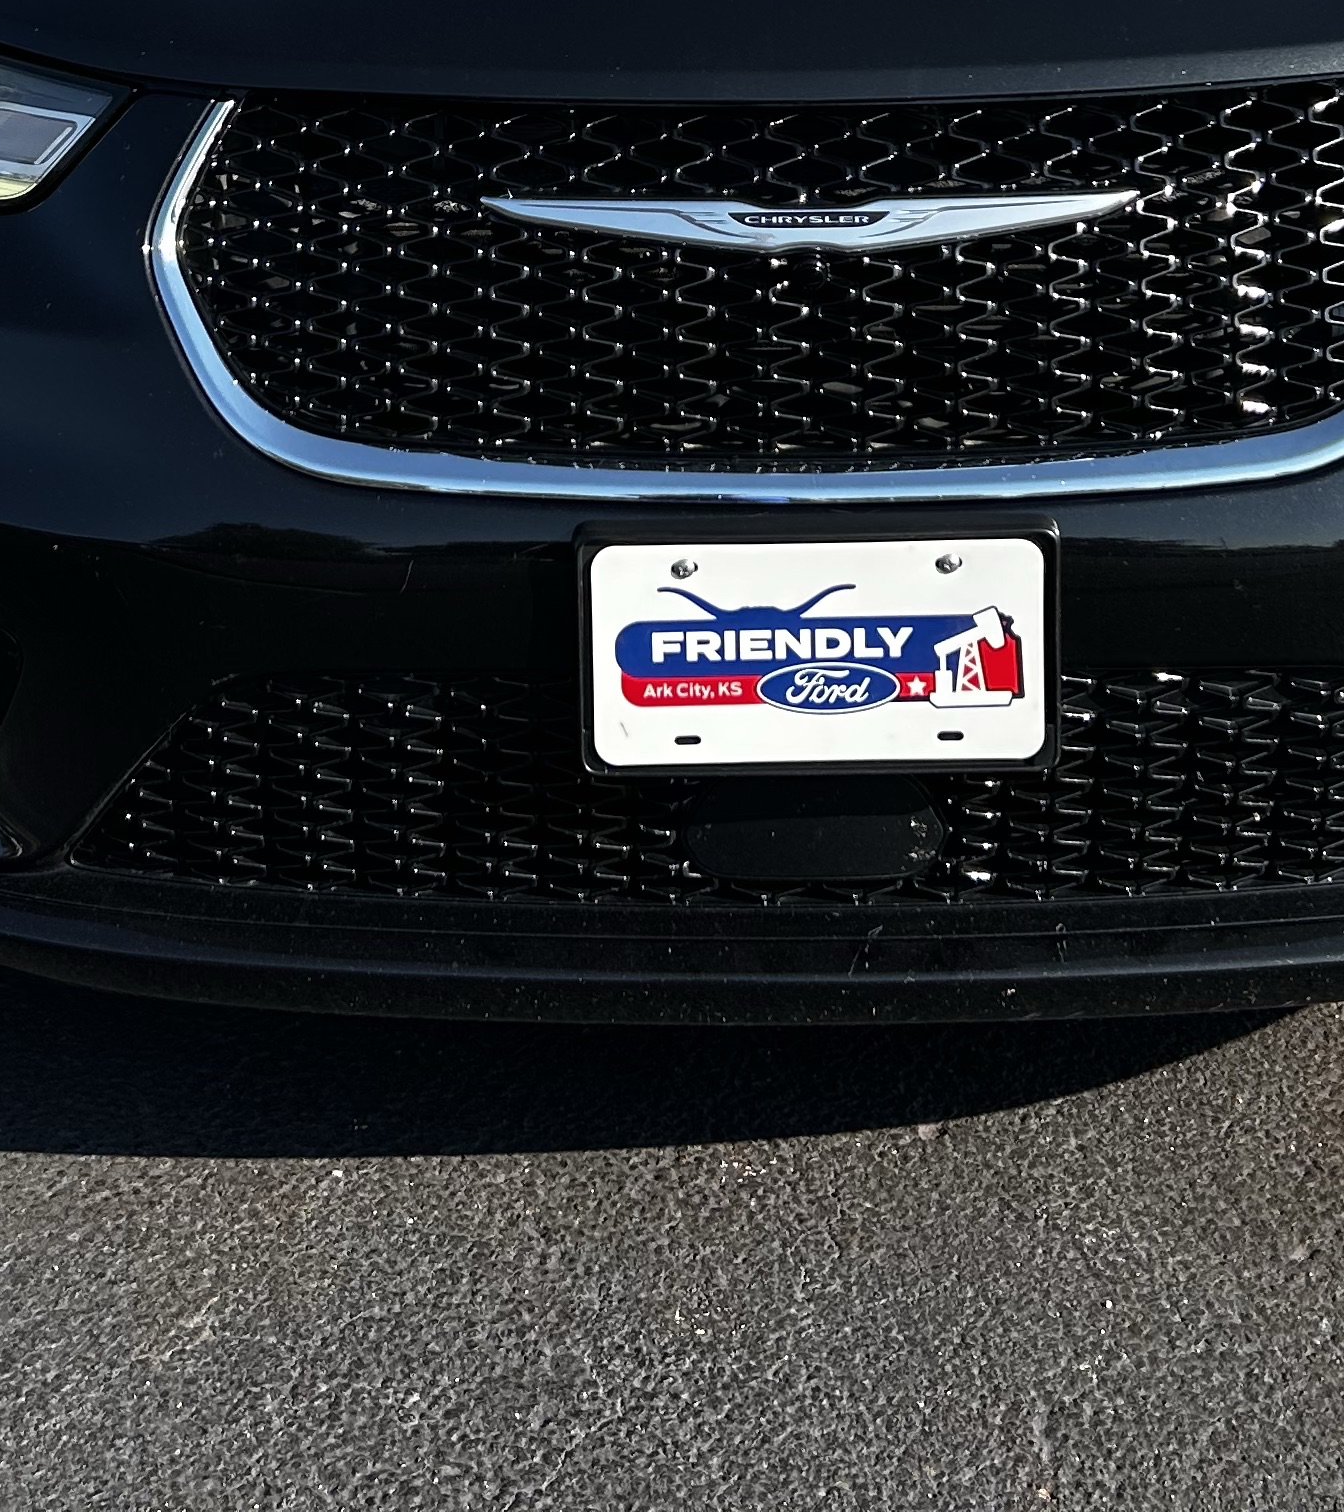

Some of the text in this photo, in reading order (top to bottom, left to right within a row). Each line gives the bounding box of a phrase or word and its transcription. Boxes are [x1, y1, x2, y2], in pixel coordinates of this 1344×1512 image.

[744, 215, 870, 224] CHRYSLER
[651, 627, 914, 663] FRIENDLY
[643, 681, 743, 699] Ark City, KS
[785, 668, 871, 704] Ford
